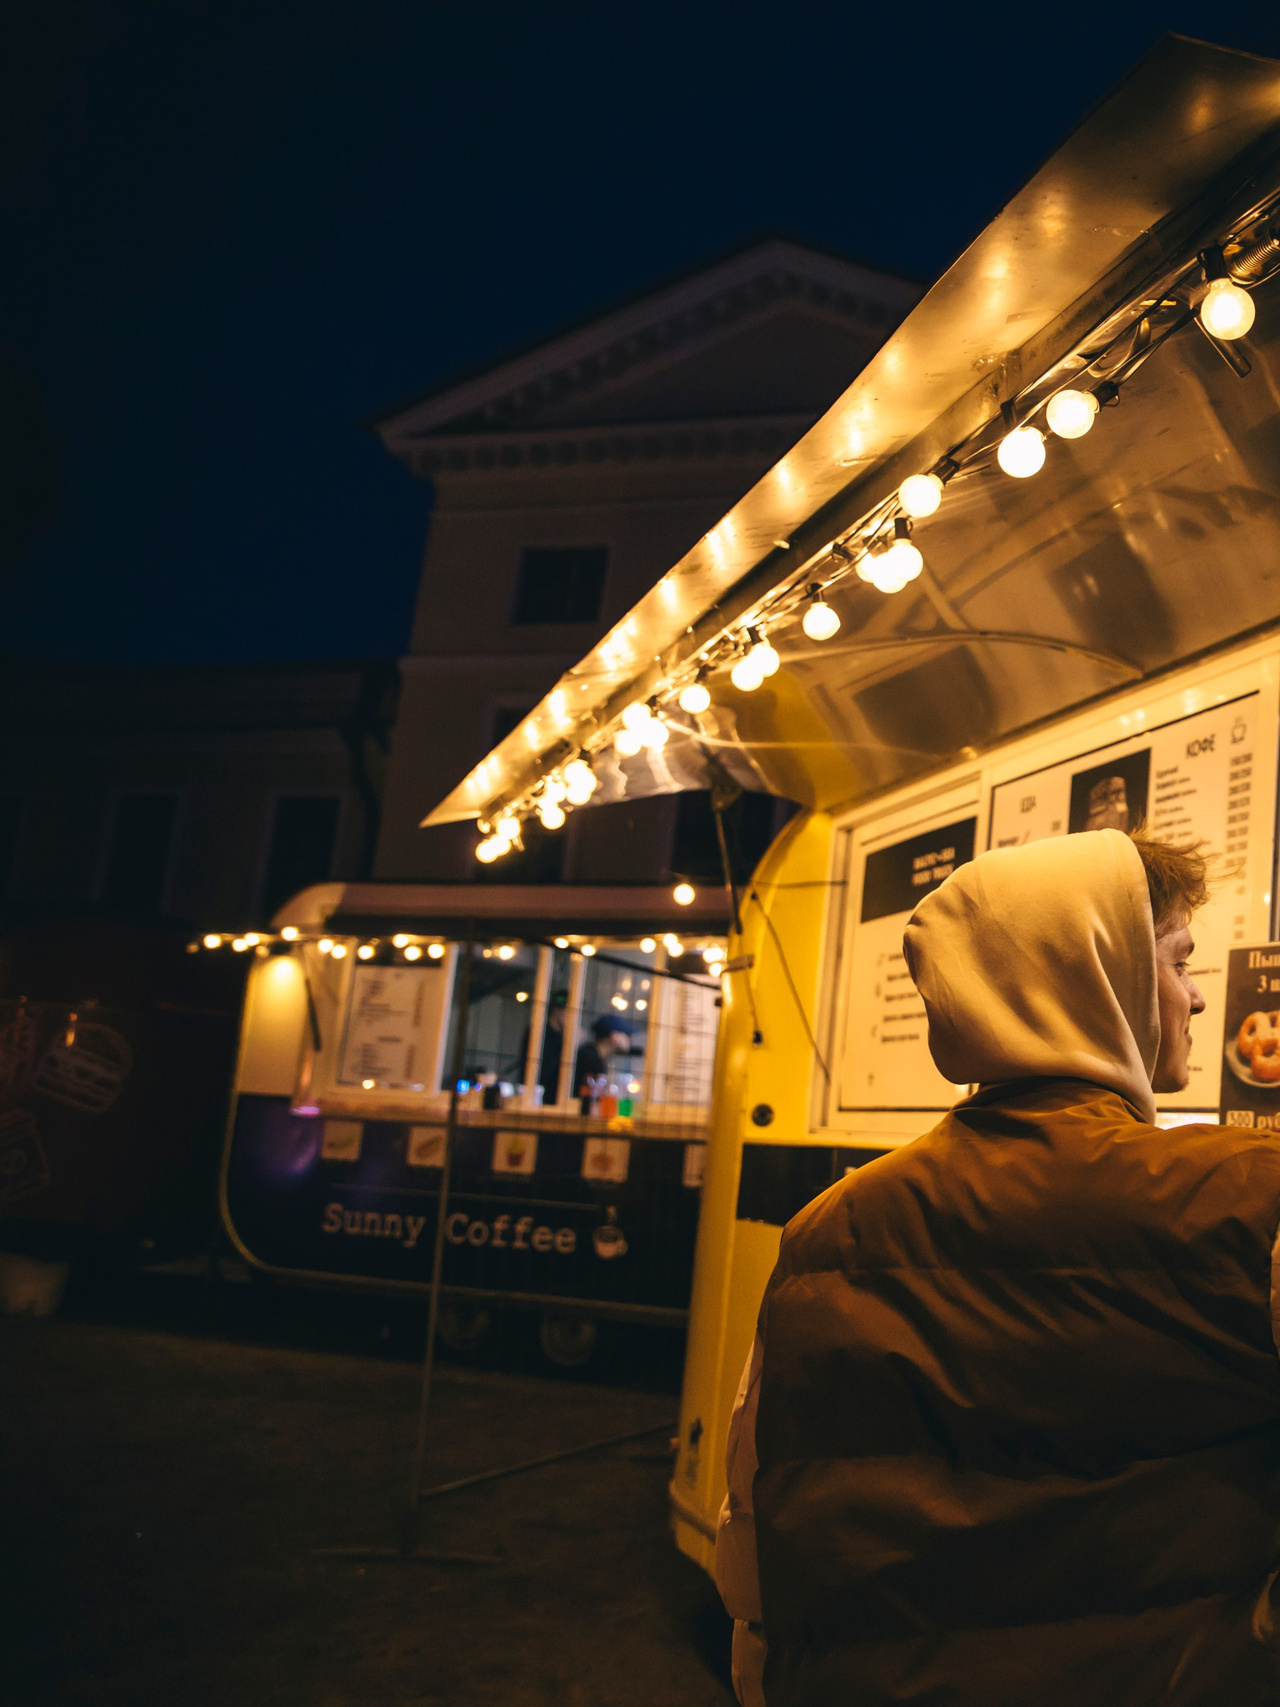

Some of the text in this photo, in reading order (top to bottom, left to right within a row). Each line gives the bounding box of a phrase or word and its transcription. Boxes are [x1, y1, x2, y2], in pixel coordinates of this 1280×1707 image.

[1185, 733, 1217, 760] КОФЕ
[1256, 974, 1267, 994] 3
[321, 1202, 577, 1255] Sunny Coffee
